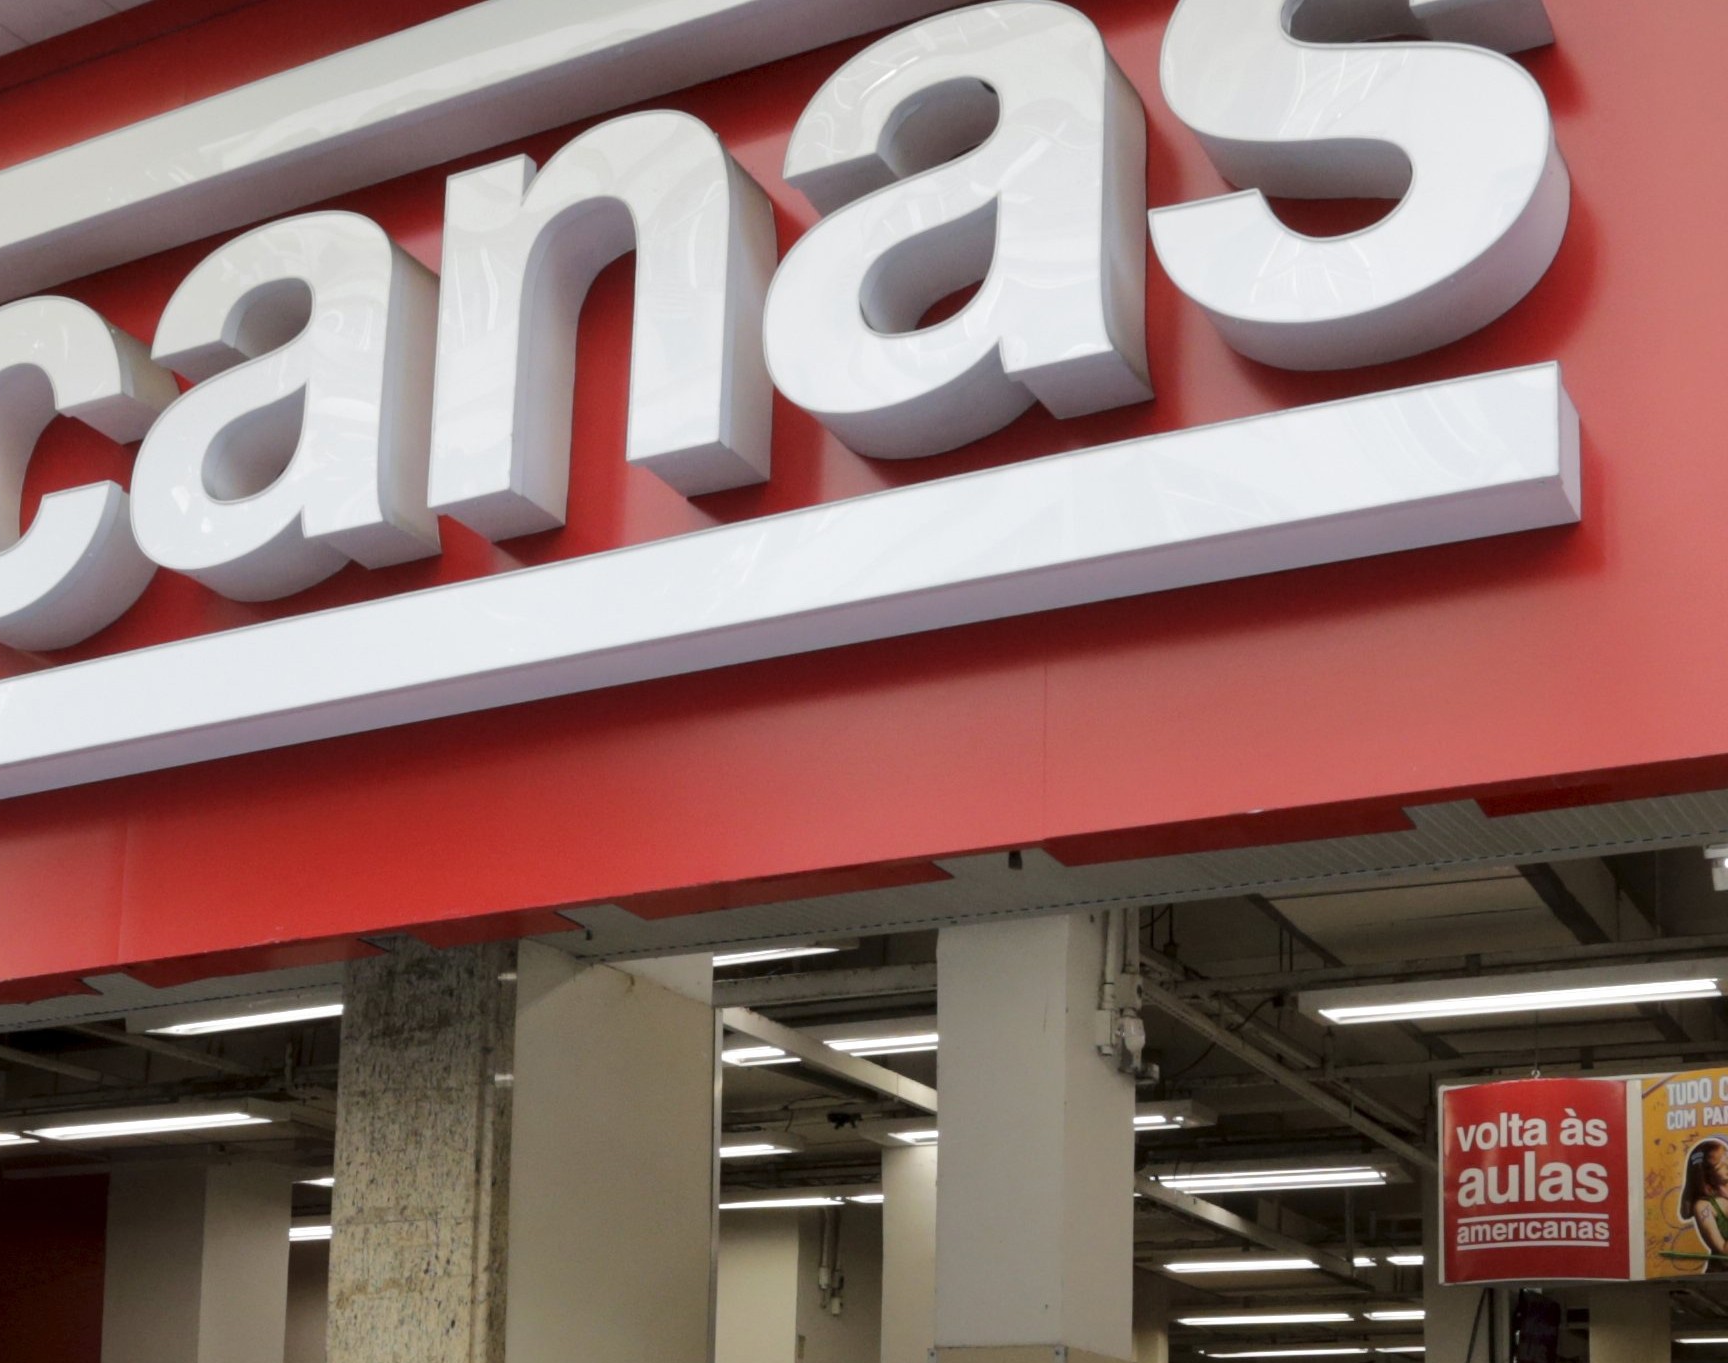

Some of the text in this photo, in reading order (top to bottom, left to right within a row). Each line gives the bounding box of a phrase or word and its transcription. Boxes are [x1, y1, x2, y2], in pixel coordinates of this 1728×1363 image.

[1666, 1077, 1712, 1106] TUDO
[1457, 1108, 1608, 1152] volta às
[1666, 1109, 1696, 1130] COM
[1458, 1151, 1609, 1208] aulas
[1457, 1221, 1610, 1245] americanas
